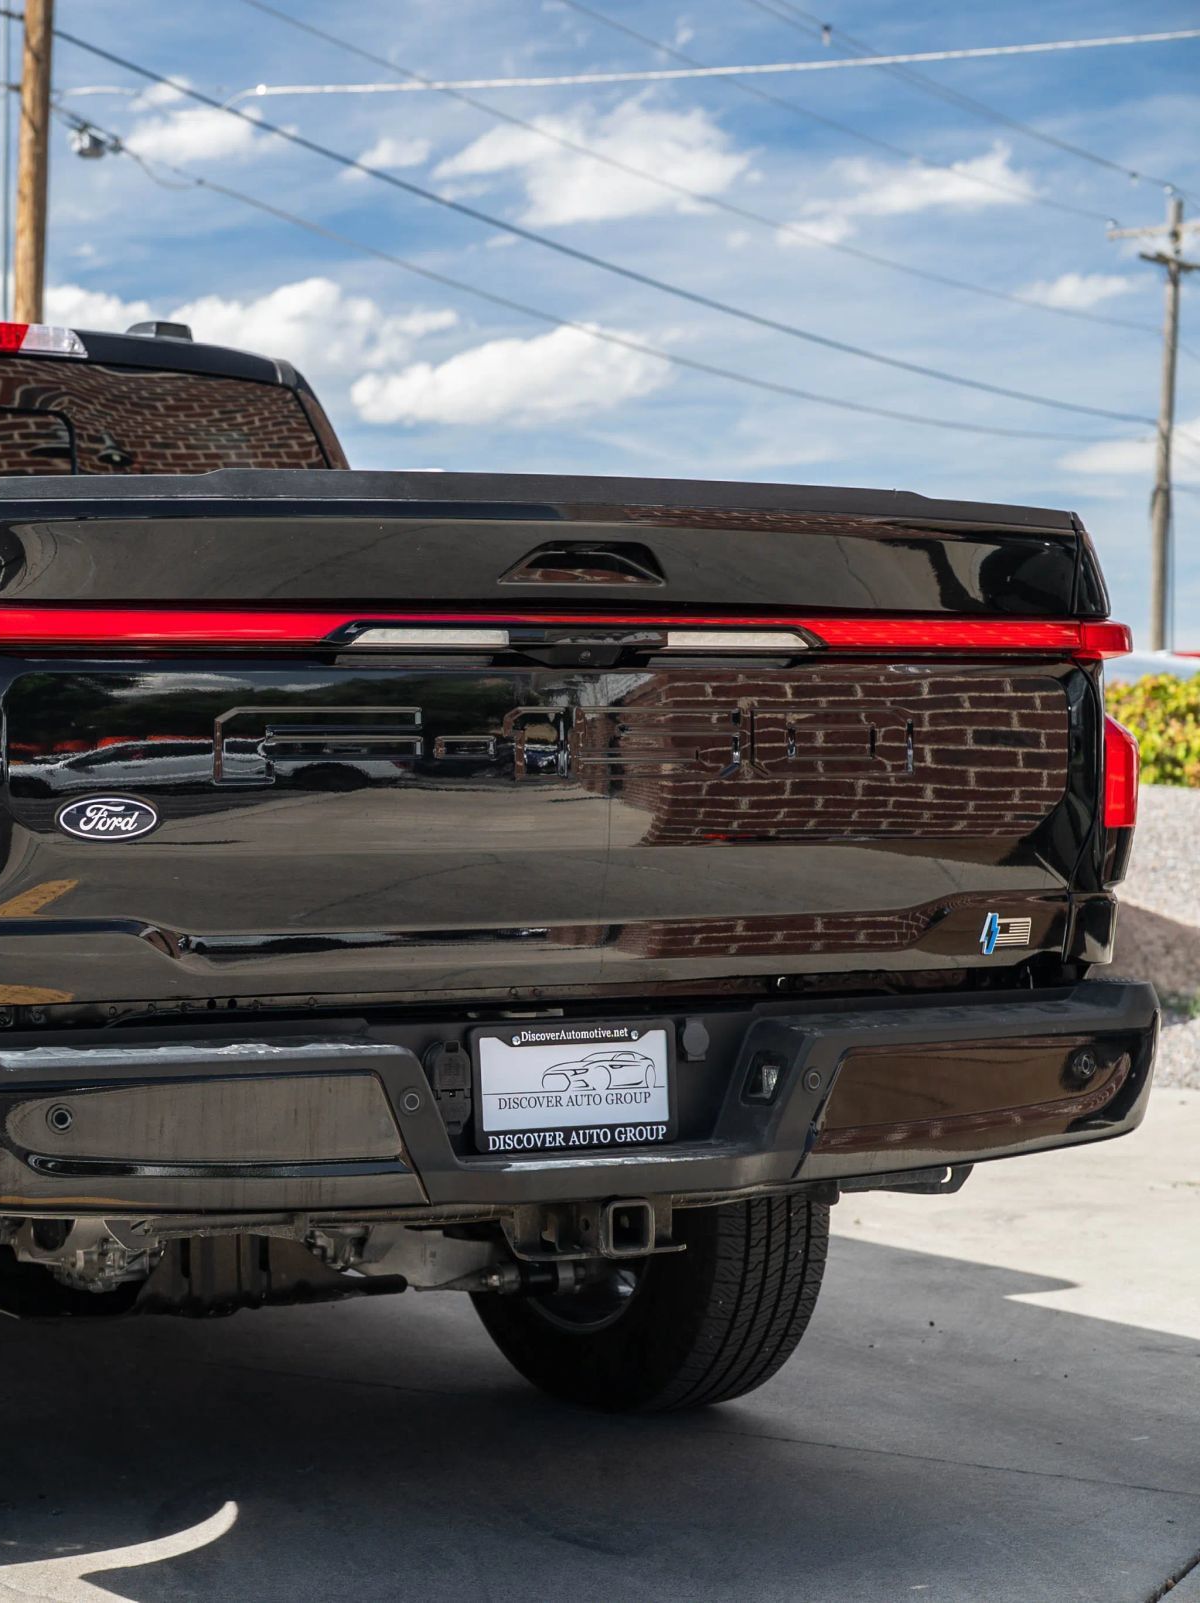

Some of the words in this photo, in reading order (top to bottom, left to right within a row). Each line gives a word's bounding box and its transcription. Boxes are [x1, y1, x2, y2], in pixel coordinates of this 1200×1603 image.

[79, 804, 139, 831] Ford
[521, 1027, 629, 1042] DiscoverAutomotive.net
[498, 1095, 563, 1110] DISCOVER
[566, 1093, 602, 1107] AUTO
[605, 1091, 651, 1105] GROUP
[488, 1131, 566, 1151] DISCOVER
[569, 1128, 611, 1146] AUTO
[615, 1125, 667, 1143] GROUP
